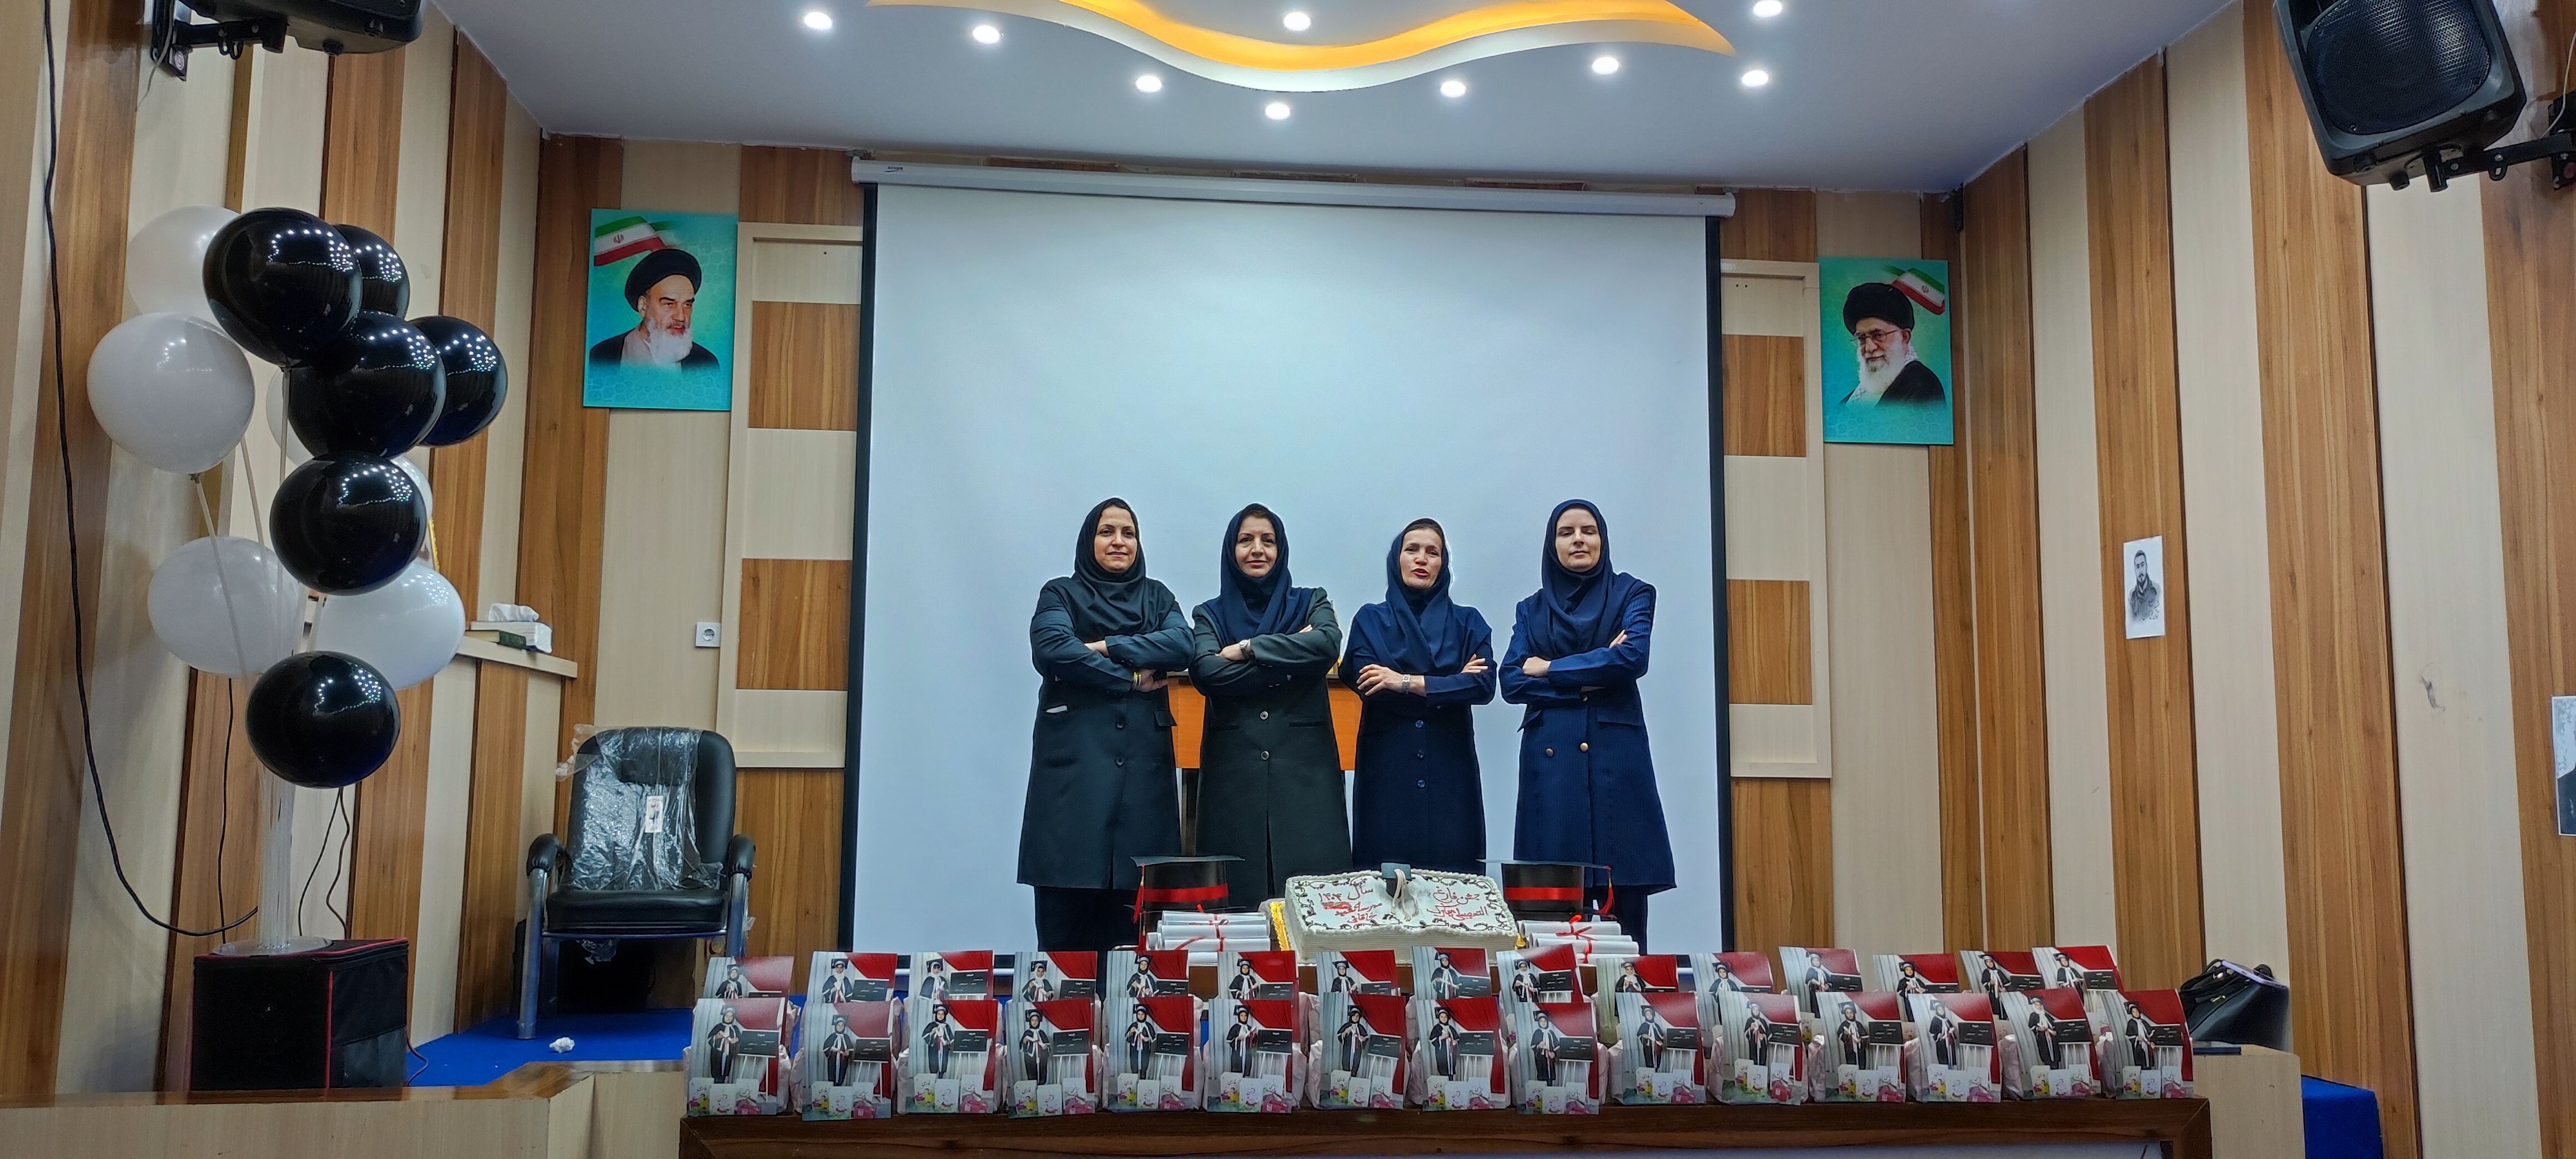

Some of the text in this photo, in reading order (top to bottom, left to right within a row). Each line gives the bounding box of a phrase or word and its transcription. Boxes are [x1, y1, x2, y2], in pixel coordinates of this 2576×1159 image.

[1348, 883, 1373, 900] سال
[1433, 886, 1480, 904] جشن فارغ
[1426, 903, 1458, 917] مبارک
